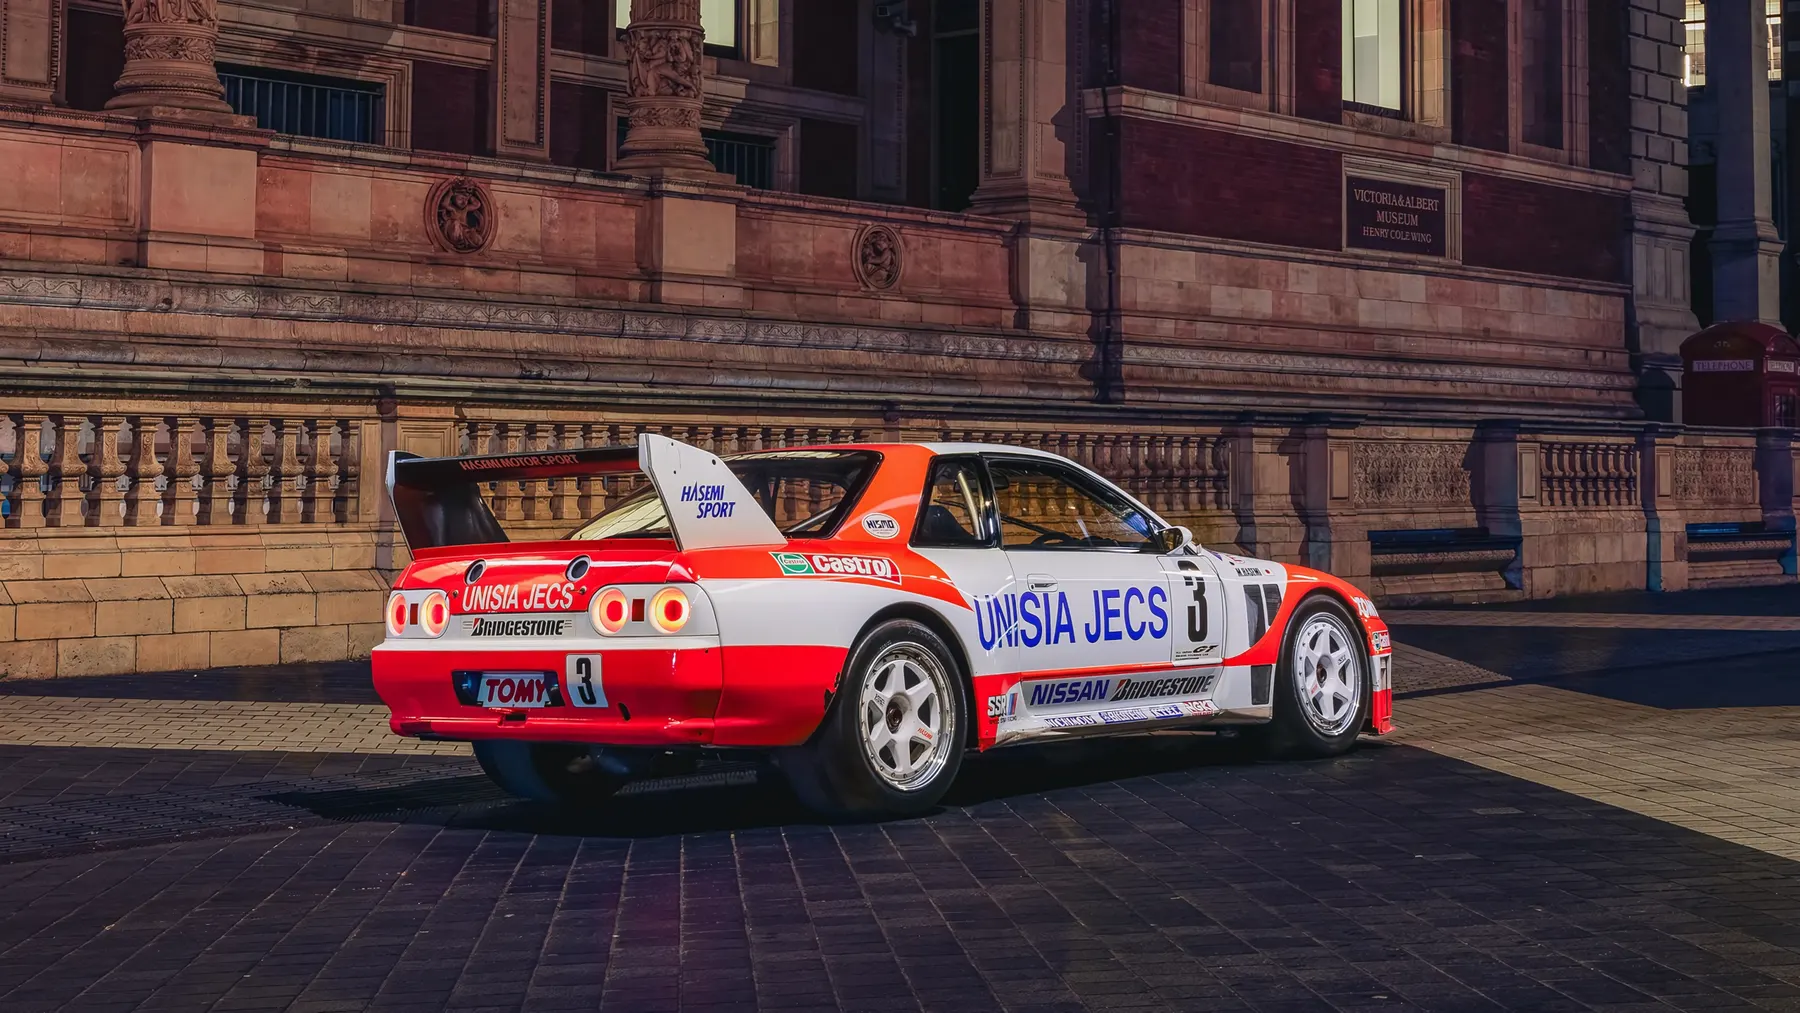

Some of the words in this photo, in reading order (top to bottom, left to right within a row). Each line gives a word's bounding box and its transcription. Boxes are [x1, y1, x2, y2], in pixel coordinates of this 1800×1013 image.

[1377, 211, 1418, 226] MUSEUM
[1363, 226, 1389, 238] HENRY
[1390, 230, 1410, 240] COLE
[1411, 232, 1431, 243] WING
[1696, 361, 1752, 370] TELEPHONE
[460, 460, 500, 470] HASEMI
[500, 457, 541, 468] MOTOR
[541, 454, 579, 465] SPORT
[681, 481, 725, 501] HASEMI
[697, 502, 736, 518] SPORT
[866, 520, 894, 528] NISMO
[812, 555, 892, 577] Castrol
[462, 584, 518, 611] UNISIA
[523, 583, 574, 609] JECS
[1177, 560, 1208, 642] 3
[471, 618, 564, 636] BRIDGESTONE
[974, 591, 1076, 651] UNISIA
[1085, 585, 1168, 644] JECS
[1193, 645, 1219, 653] GT
[486, 678, 545, 703] TOMY
[576, 657, 597, 705] 3
[1030, 680, 1110, 706] NISSAN
[1110, 675, 1215, 701] BRIDGESTONE
[987, 695, 1007, 717] SSR
[1185, 700, 1214, 713] NGK
